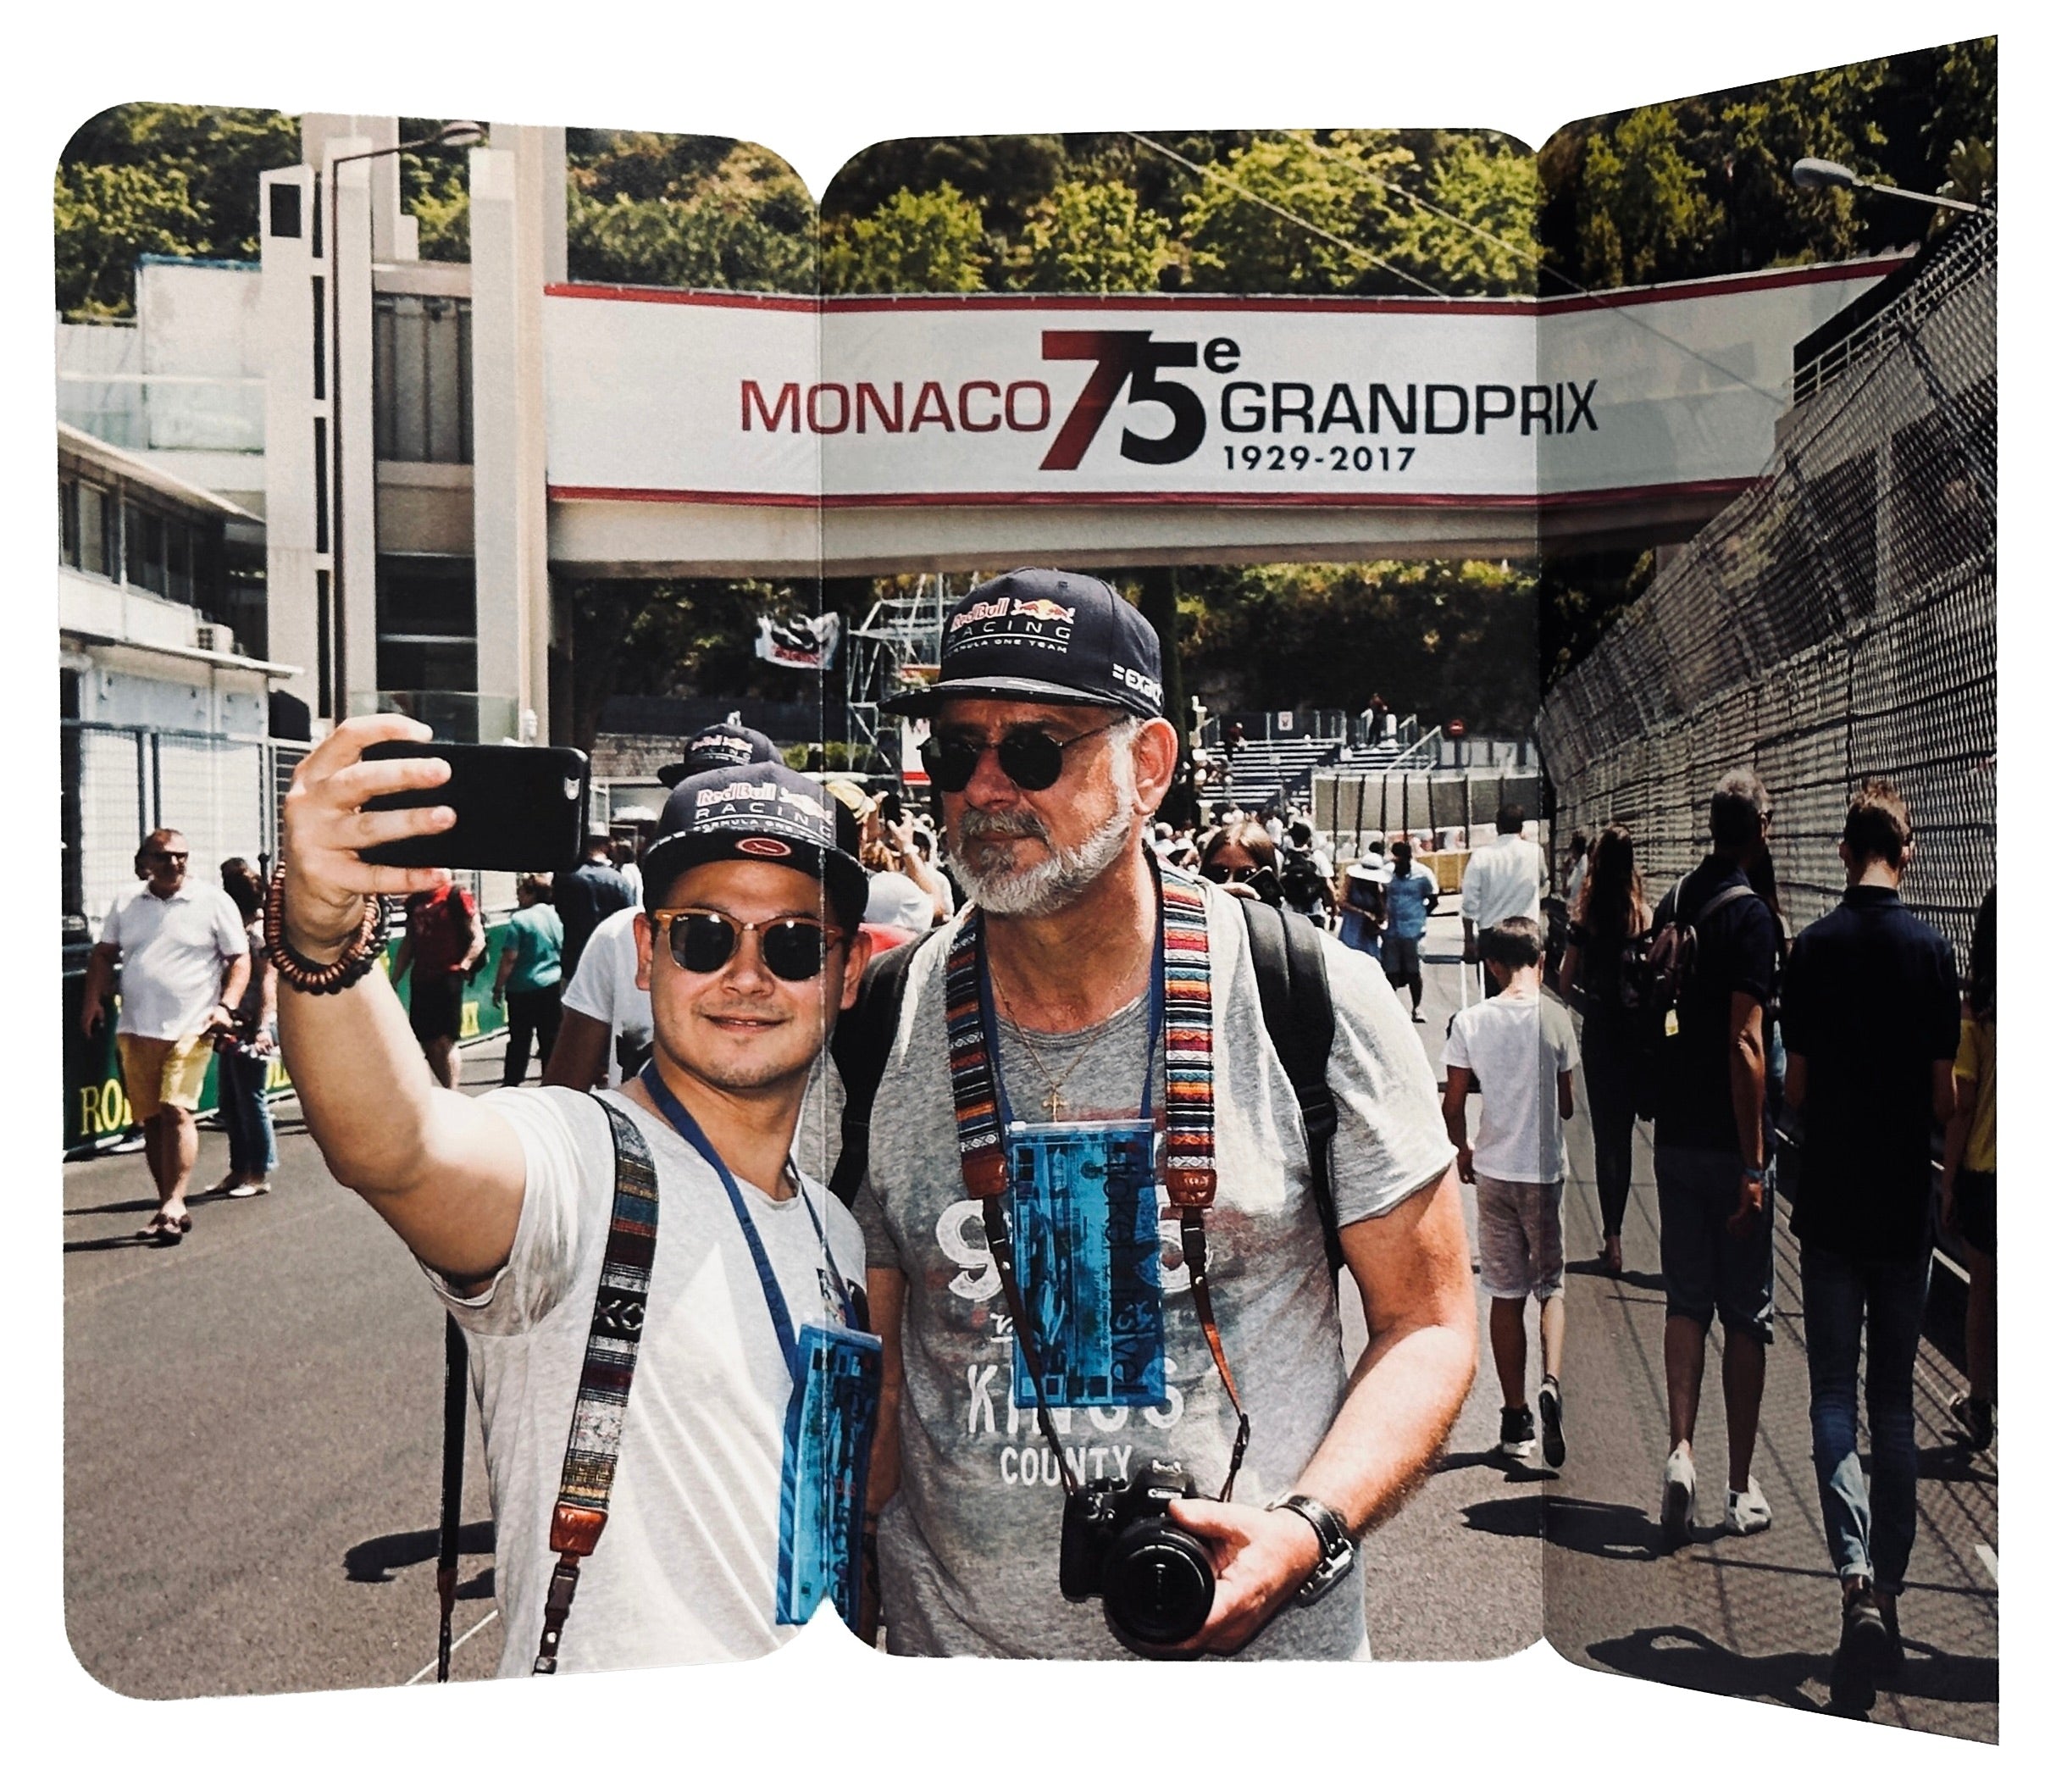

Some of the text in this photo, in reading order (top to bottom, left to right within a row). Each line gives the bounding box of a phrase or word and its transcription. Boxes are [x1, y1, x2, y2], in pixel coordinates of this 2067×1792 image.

[740, 379, 1052, 436] MONACO
[1222, 445, 1416, 473] 1929-2017
[695, 802, 834, 840] RACING
[1000, 1445, 1133, 1487] COUNTY
